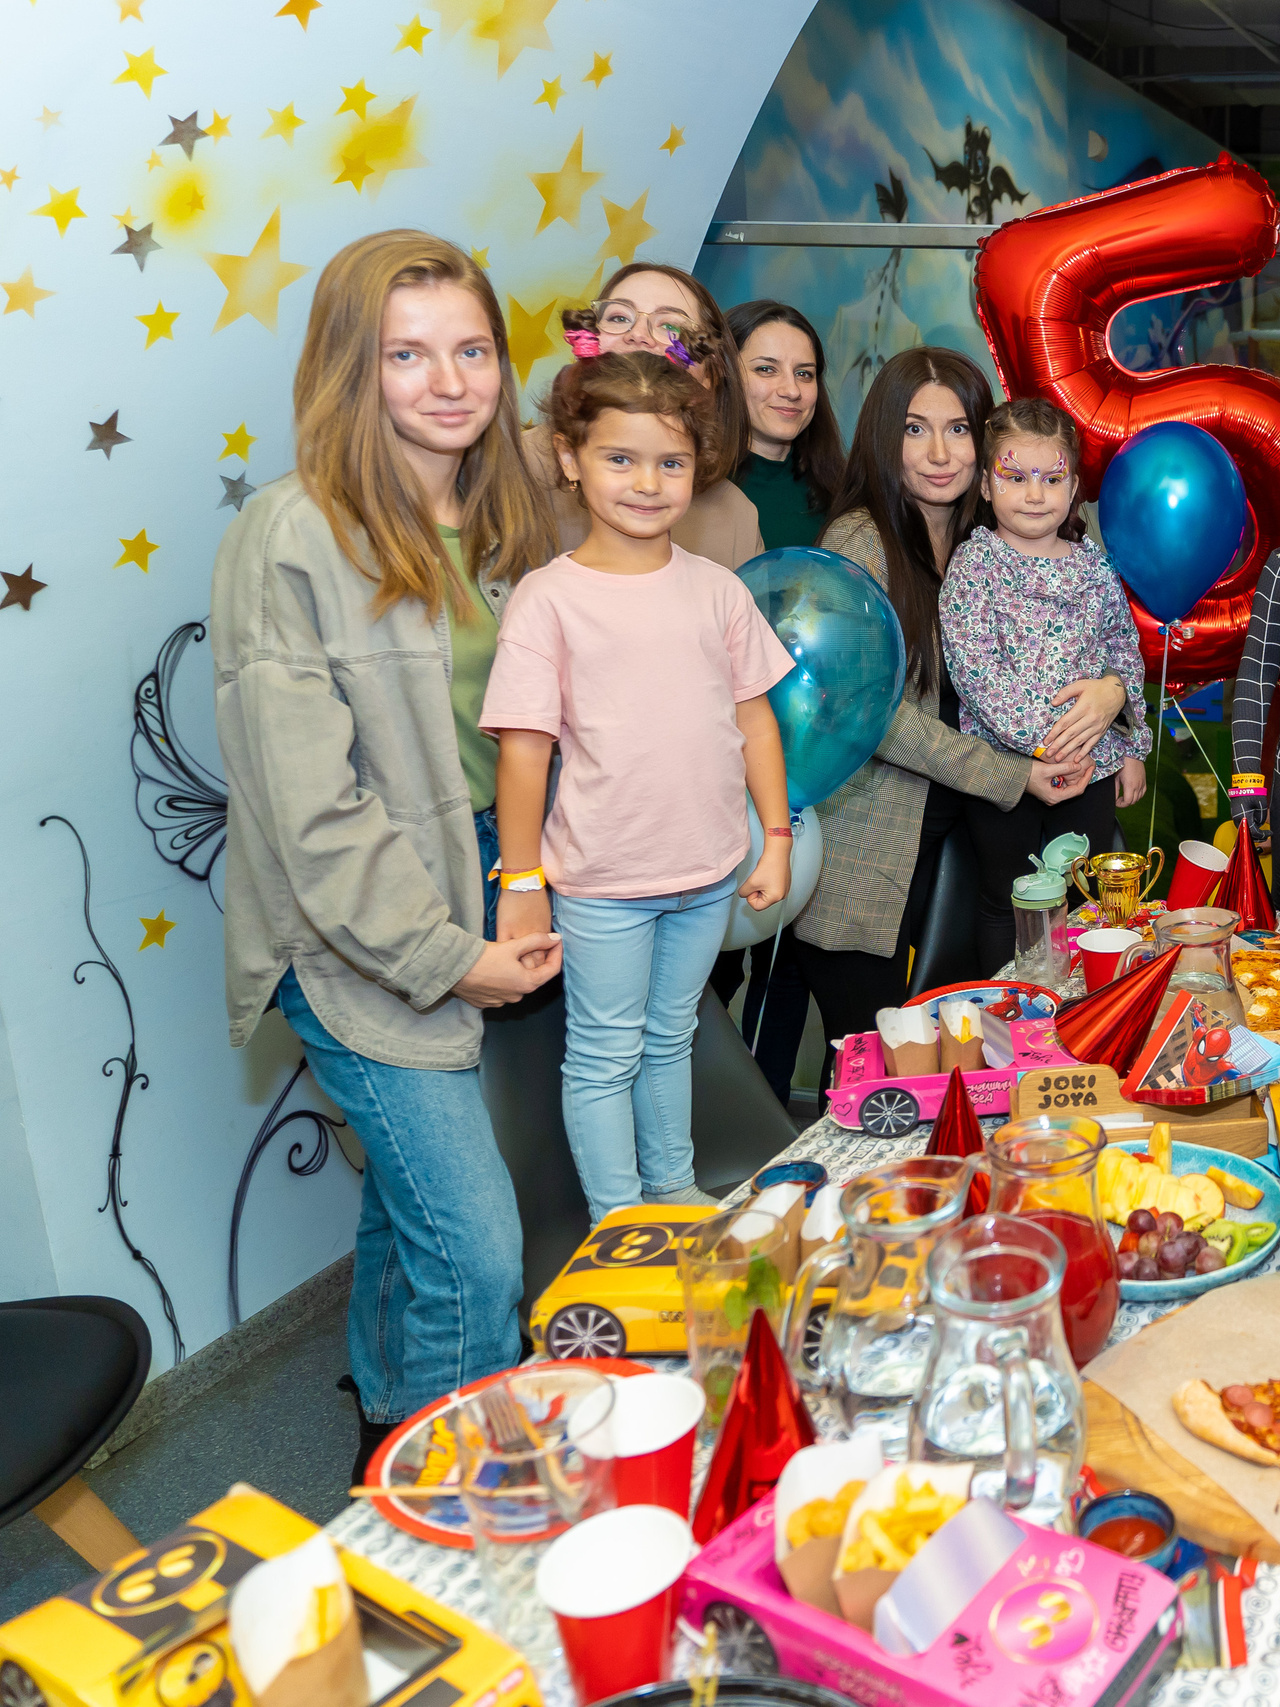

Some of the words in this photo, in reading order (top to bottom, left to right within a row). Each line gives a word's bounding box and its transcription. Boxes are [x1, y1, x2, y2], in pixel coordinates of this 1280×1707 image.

[965, 1078, 1012, 1094] снейший
[1038, 1074, 1097, 1092] JOKI
[1038, 1092, 1098, 1109] JOYA
